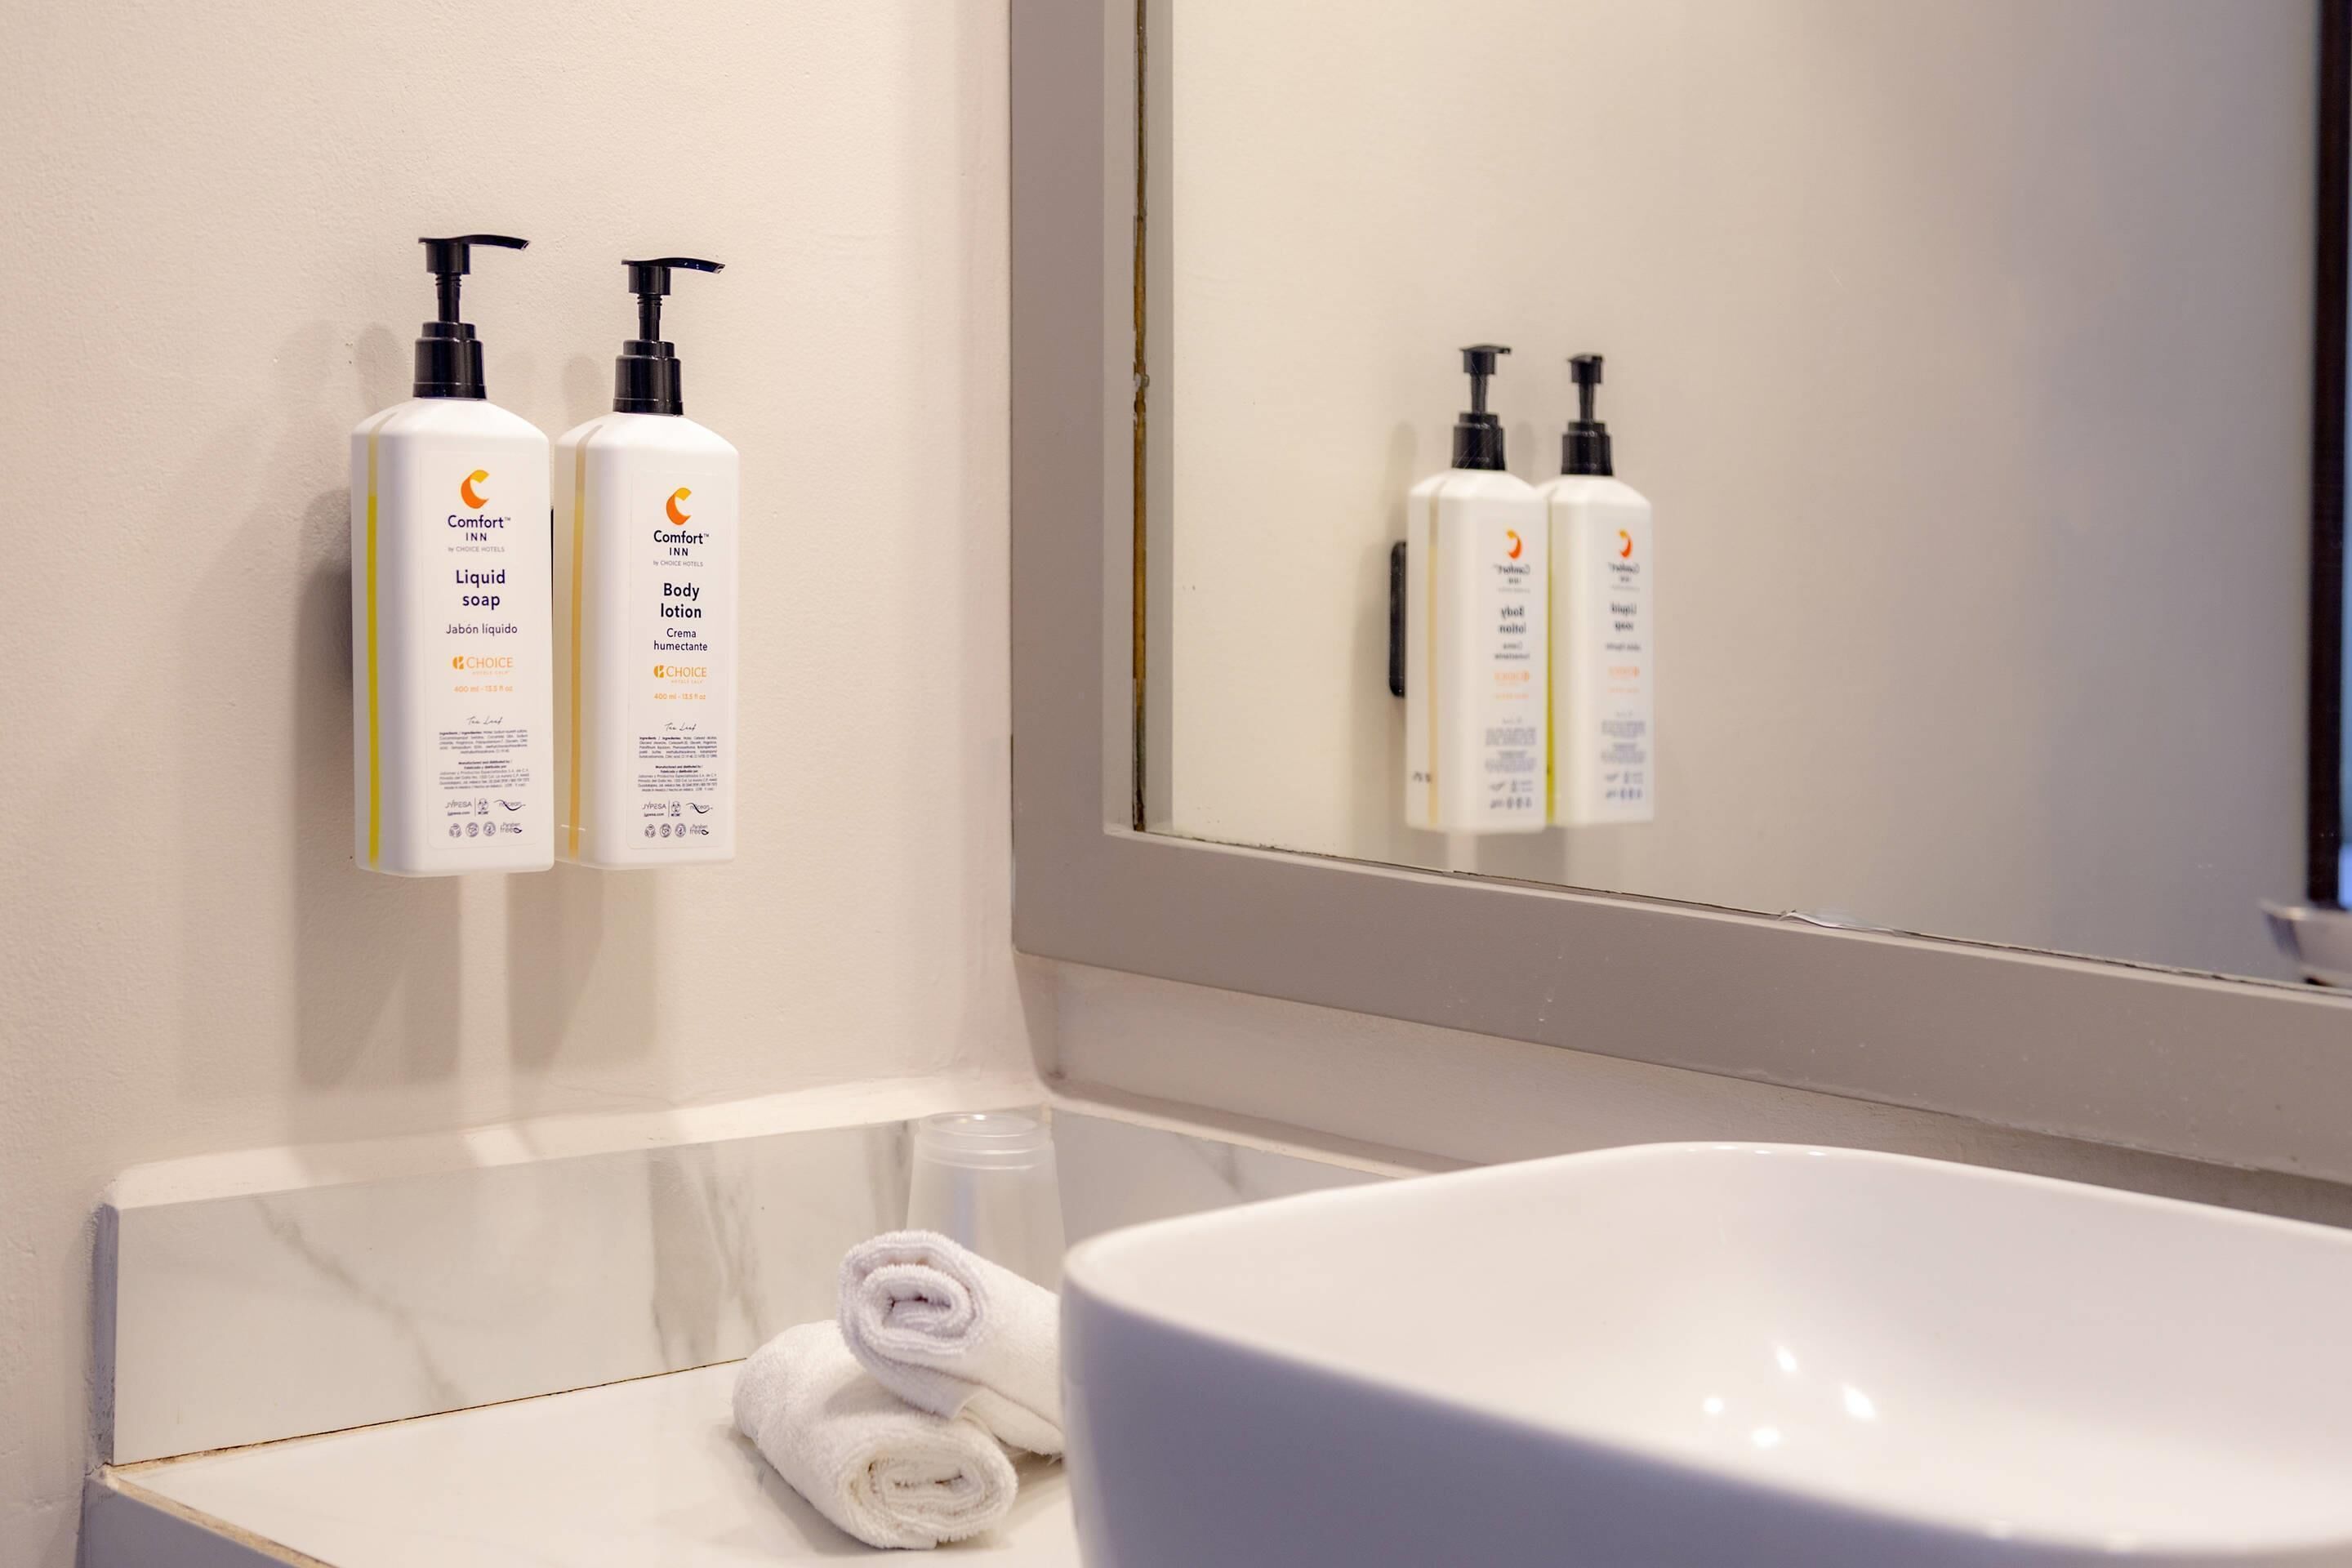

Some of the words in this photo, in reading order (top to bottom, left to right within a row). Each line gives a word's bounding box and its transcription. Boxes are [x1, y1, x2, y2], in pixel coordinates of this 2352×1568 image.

[466, 532, 488, 541] INN
[669, 547, 688, 556] INN
[456, 569, 506, 589] Liquid
[664, 582, 700, 601] Body
[462, 595, 501, 611] soap
[660, 603, 702, 618] lotion
[446, 623, 479, 635] Jabón
[482, 623, 518, 637] líquido
[666, 628, 697, 638] Crema
[653, 640, 708, 651] humectante
[466, 657, 514, 669] CHOICE
[666, 666, 707, 678] CHOICE
[642, 801, 666, 810] JYPESA
